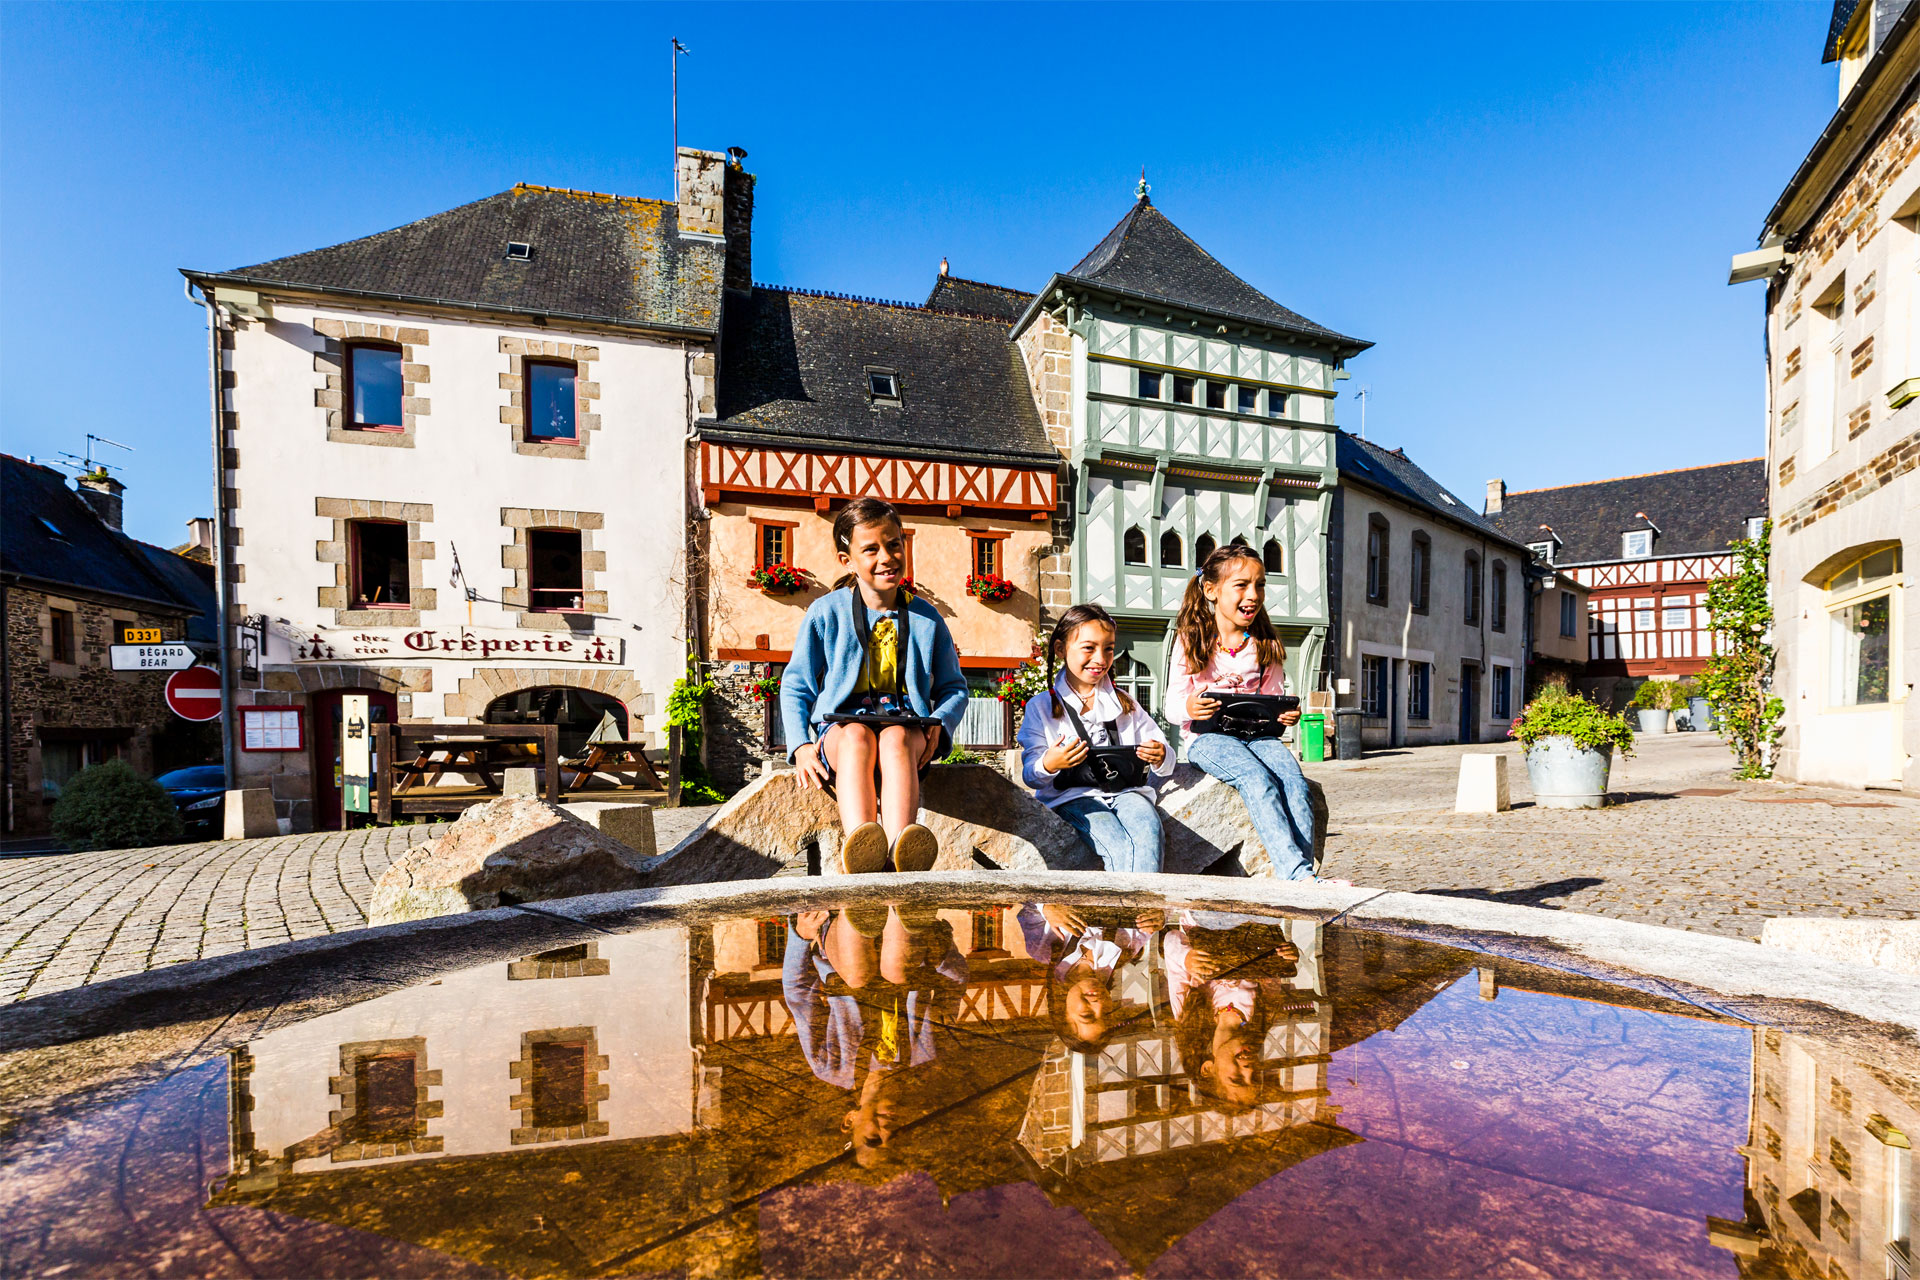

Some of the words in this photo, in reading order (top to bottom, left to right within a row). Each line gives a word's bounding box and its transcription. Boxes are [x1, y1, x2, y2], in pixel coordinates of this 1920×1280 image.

[403, 630, 573, 658] Crêperie
[139, 647, 183, 656] BÉGARD
[140, 659, 168, 667] BEAR
